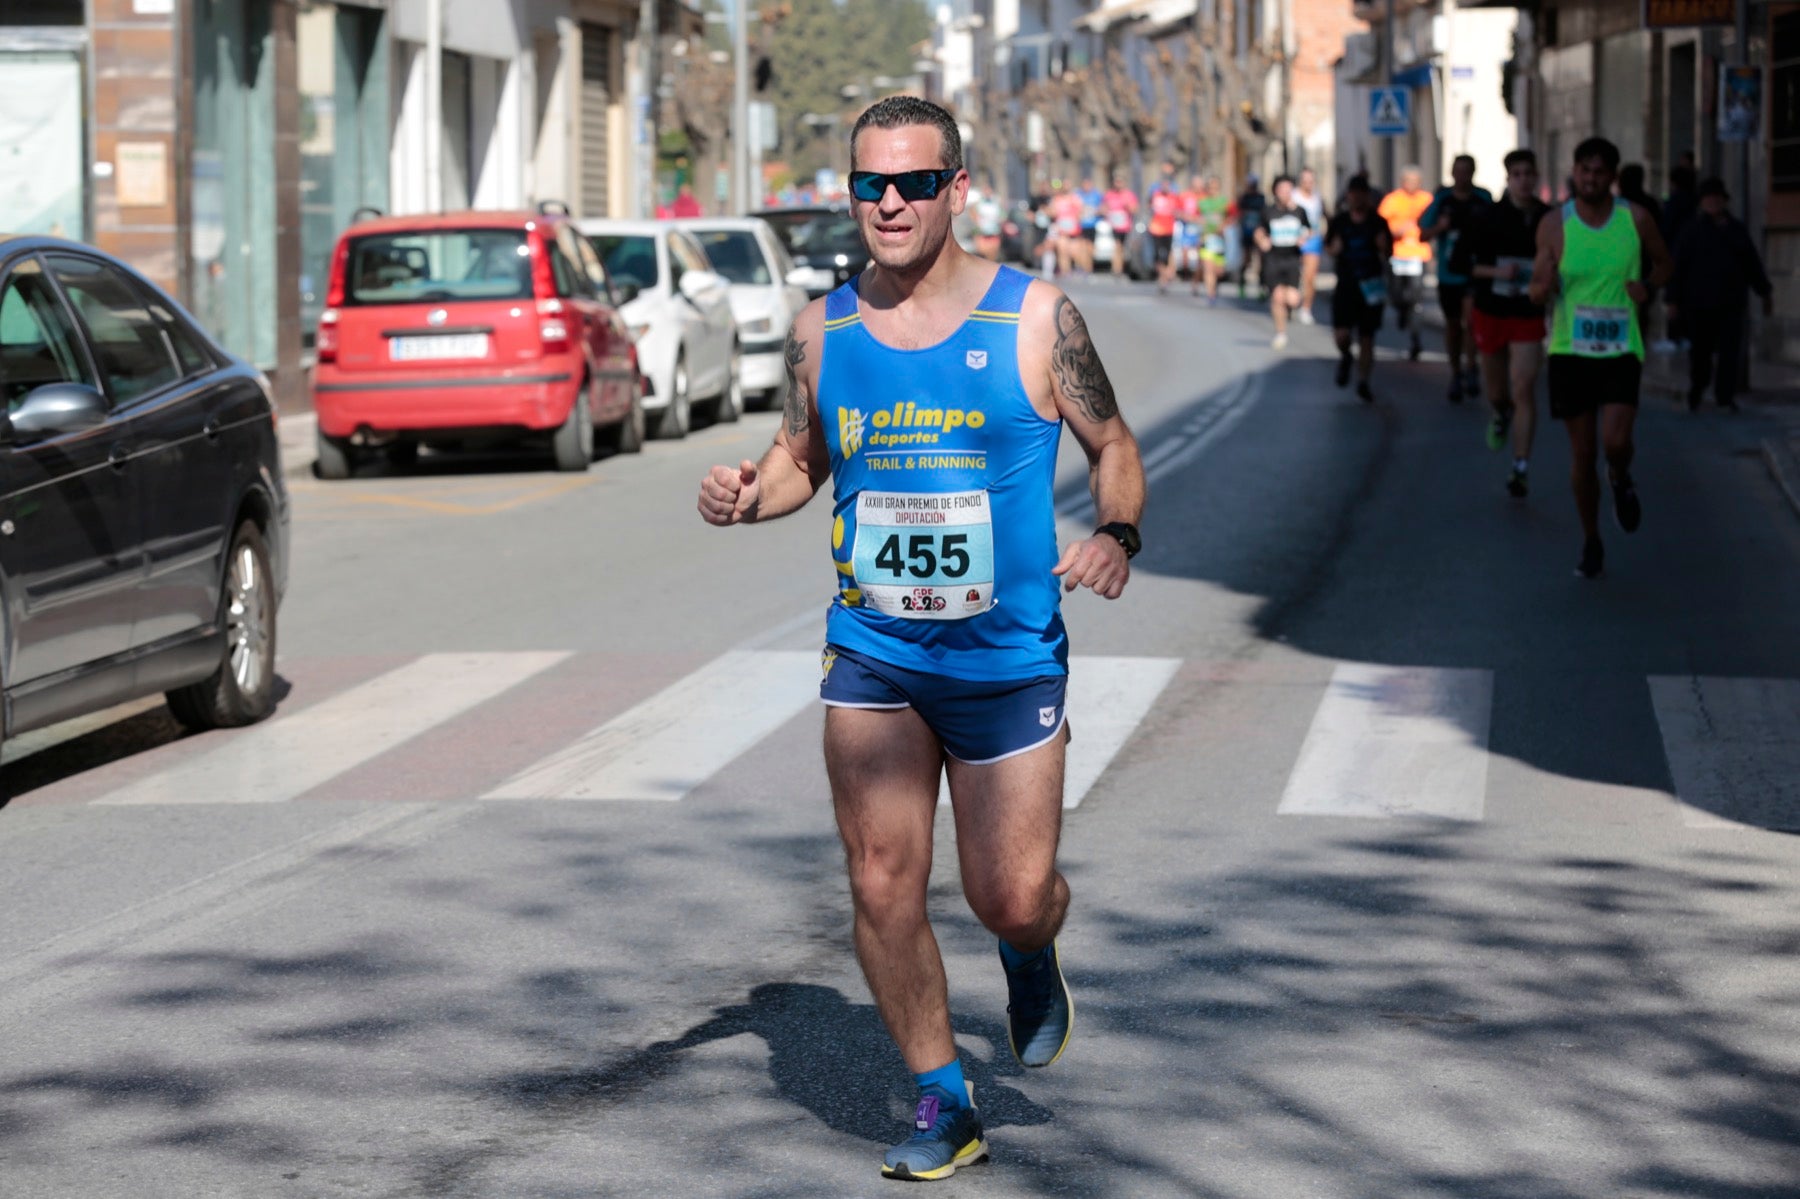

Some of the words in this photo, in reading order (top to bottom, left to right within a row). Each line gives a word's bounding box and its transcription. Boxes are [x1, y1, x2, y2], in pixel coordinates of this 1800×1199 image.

[872, 402, 985, 433] olimpo
[869, 431, 939, 447] deportes
[866, 457, 902, 470] TRAIL
[905, 457, 915, 469] &
[918, 456, 987, 469] RUNNING
[864, 496, 884, 508] XXXIII
[885, 497, 905, 509] GRAN
[908, 498, 939, 510] PREMIO
[941, 497, 952, 509] DE
[954, 495, 982, 509] FONDO
[895, 511, 946, 524] DIPUTACIÓN
[875, 534, 970, 578] 455
